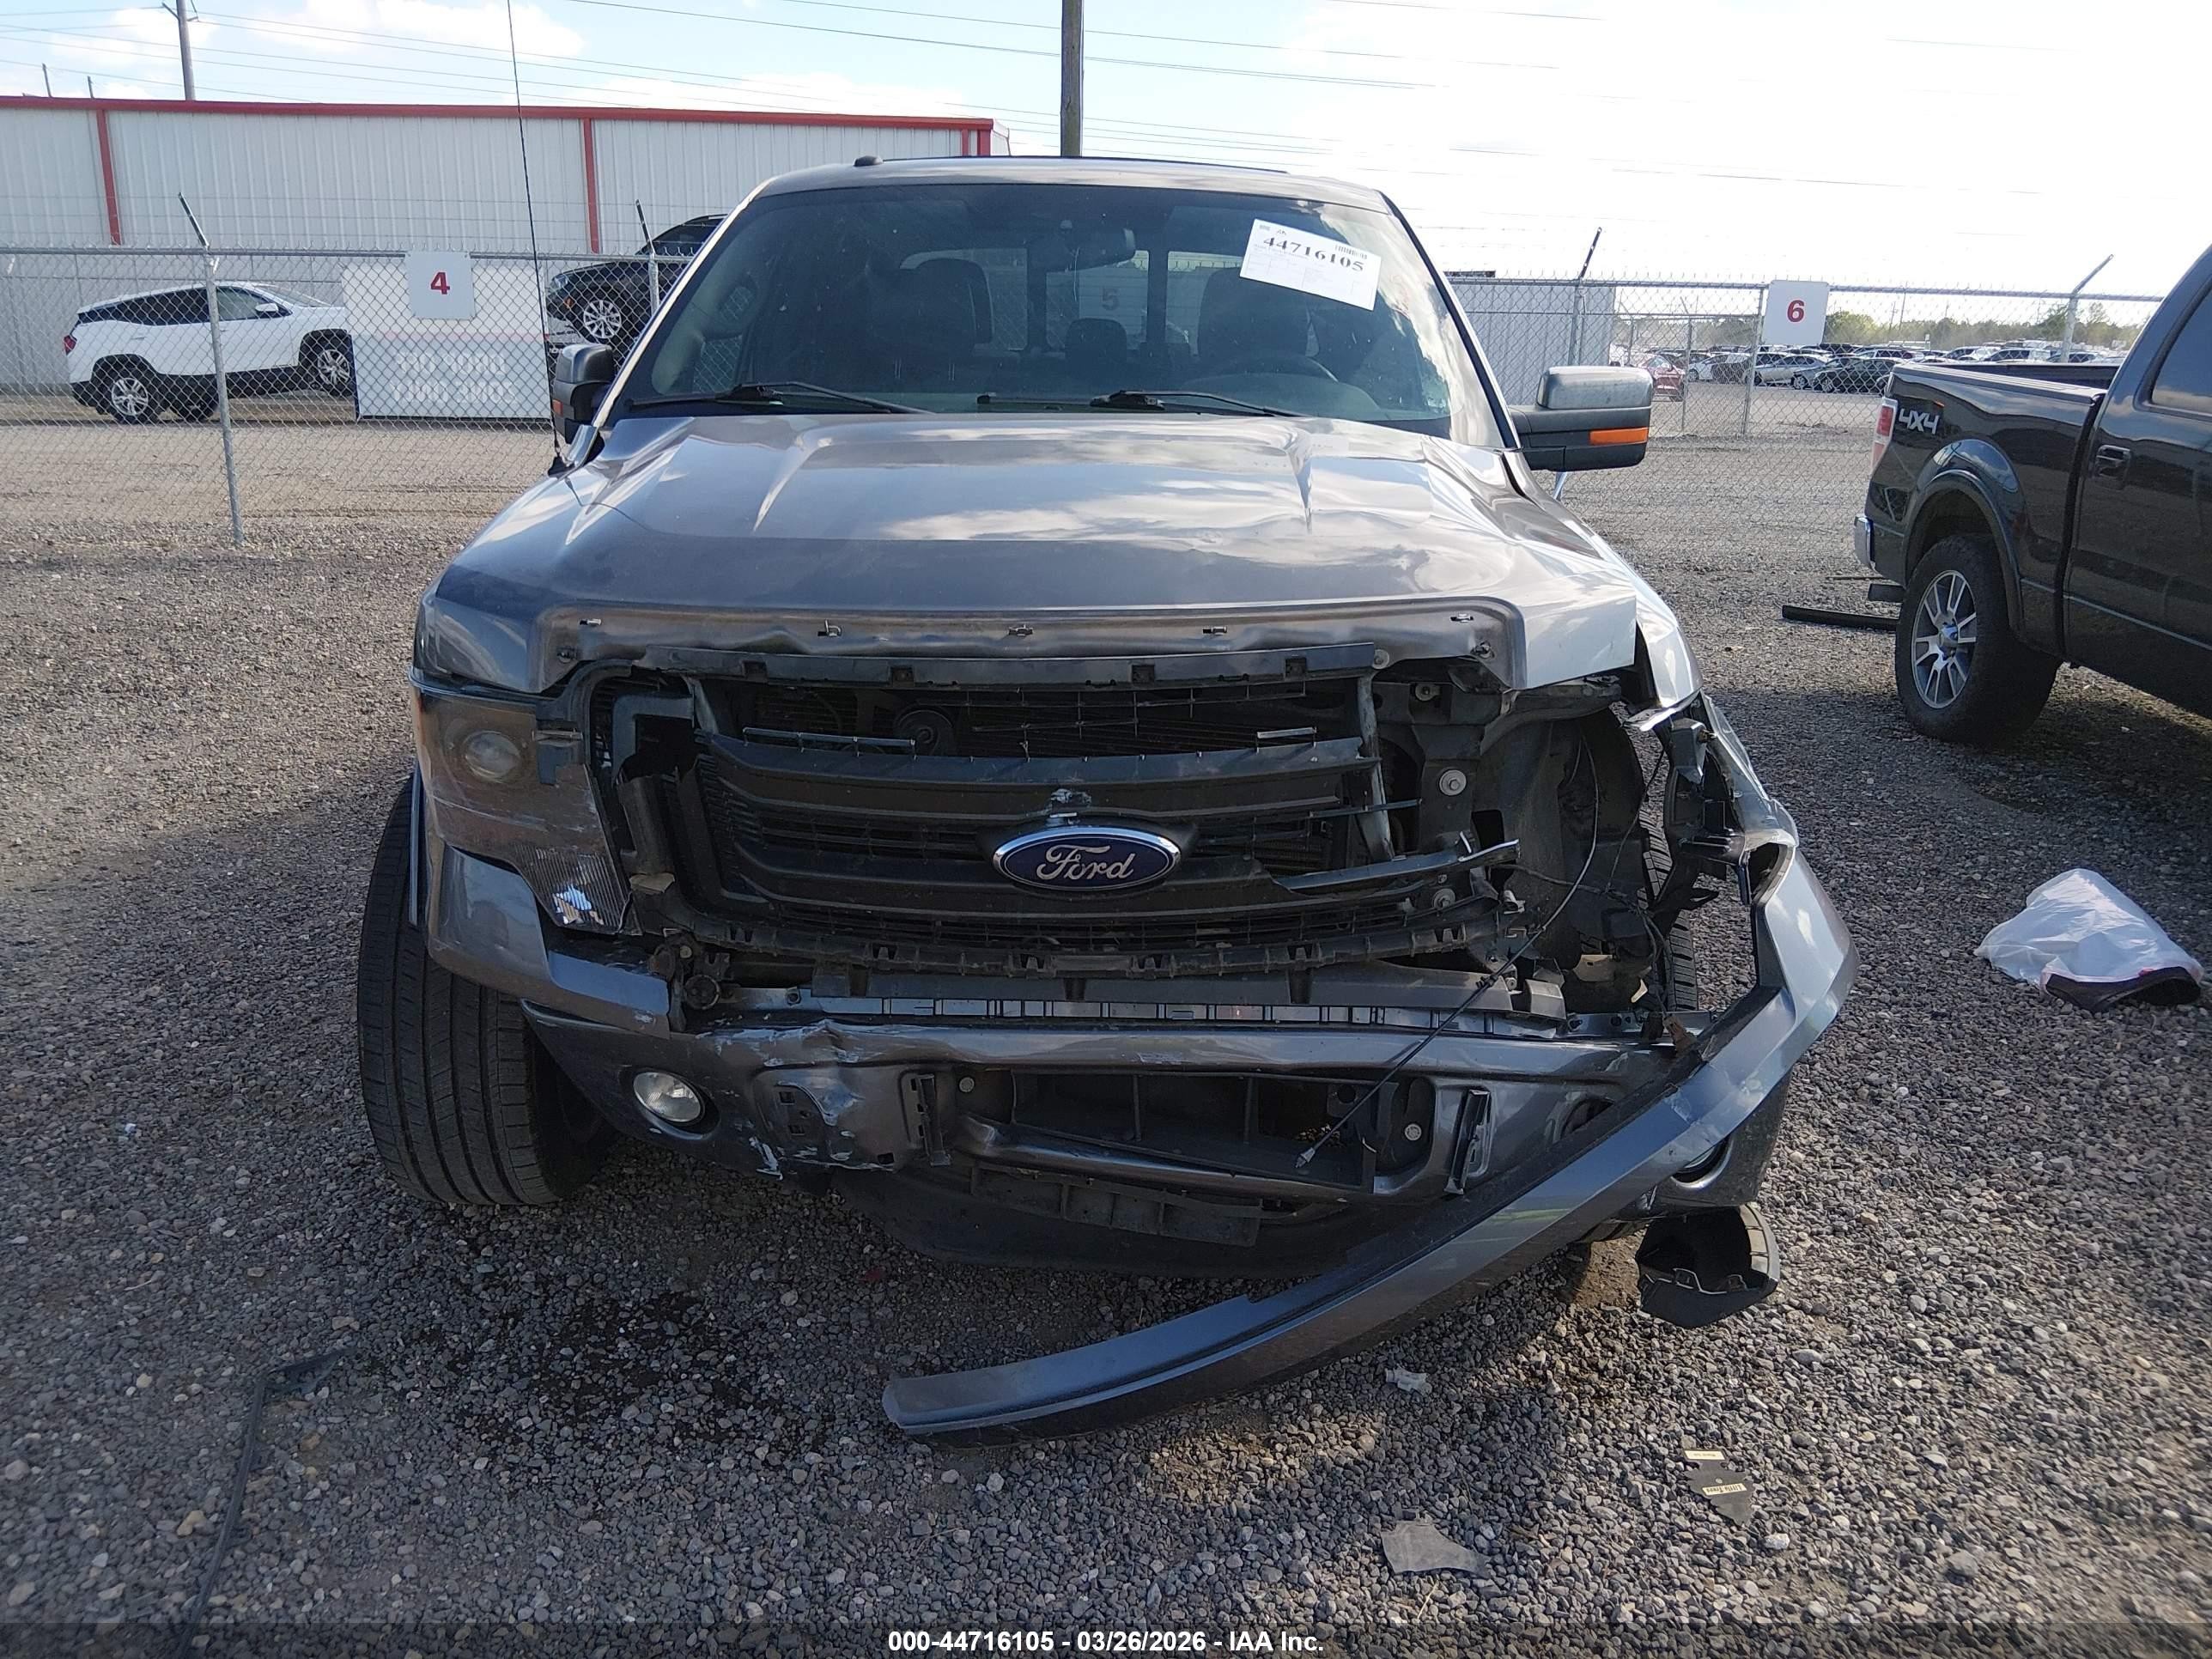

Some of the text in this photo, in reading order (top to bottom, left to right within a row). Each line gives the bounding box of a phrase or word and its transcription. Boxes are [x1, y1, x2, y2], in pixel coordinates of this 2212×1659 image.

[1263, 237, 1364, 271] 44716105
[430, 271, 450, 295] 4
[1102, 288, 1119, 311] 5
[1787, 300, 1805, 322] 6
[1036, 844, 1135, 880] Ford
